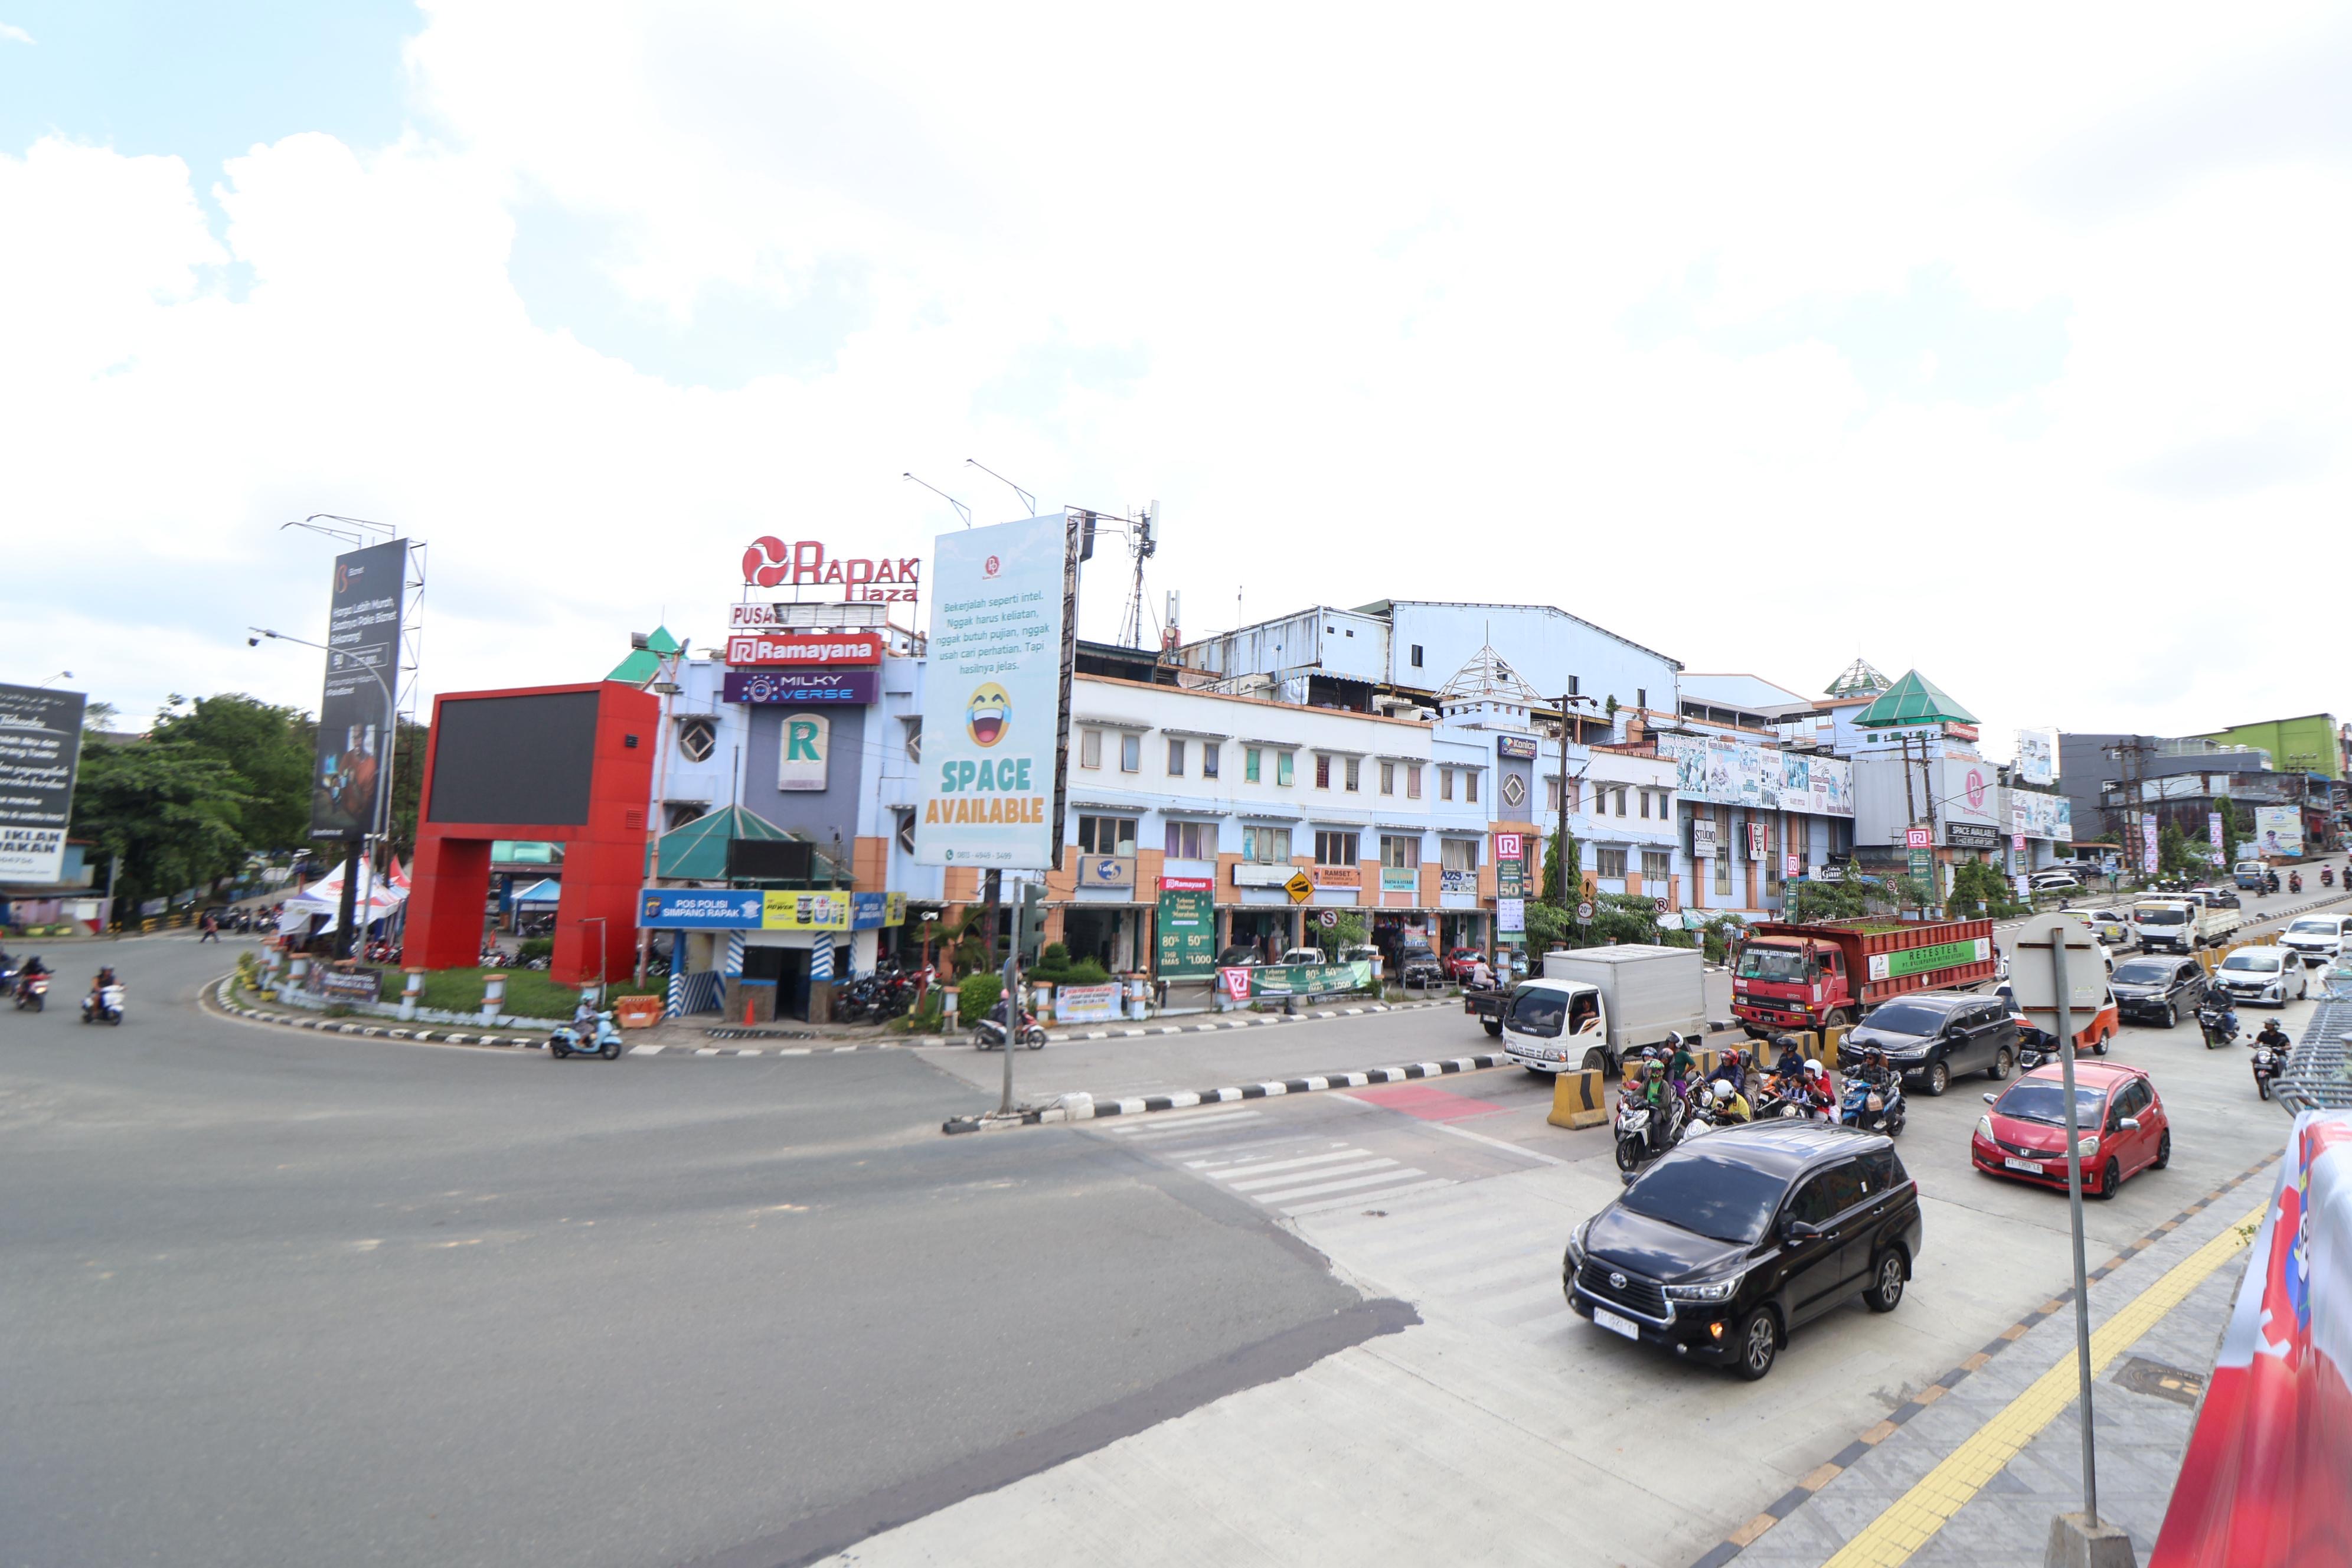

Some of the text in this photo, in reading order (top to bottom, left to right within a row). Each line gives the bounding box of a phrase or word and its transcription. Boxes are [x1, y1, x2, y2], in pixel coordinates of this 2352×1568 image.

[945, 590, 1044, 612] Bekerjalah seperti intel.
[946, 610, 1039, 629] Nggak harus keliatan,
[936, 623, 1050, 646] nggak butuh pujian, nggak
[757, 641, 872, 662] Ramayana
[939, 641, 1045, 661] usah cari perhatian. Tapi
[959, 661, 1020, 675] hasilnya jelas.
[780, 675, 843, 686] MILKY
[780, 689, 854, 700] VERSE
[1514, 739, 1536, 751] Konica
[942, 758, 1031, 792] SPACE
[926, 798, 1044, 824] AVAILABLE
[1696, 829, 1715, 843] STUDIO
[1952, 826, 1996, 837] SPACE AVAILABLE
[1500, 883, 1519, 897] 50
[677, 900, 728, 909] POS POLISI
[1580, 906, 1587, 914] 20
[662, 908, 740, 917] SIMPANG RAPAK
[1162, 936, 1180, 948] 80%
[1769, 950, 1799, 958] MENUMPANG
[1909, 945, 1958, 961] RETESTER
[1306, 969, 1320, 979] 80%
